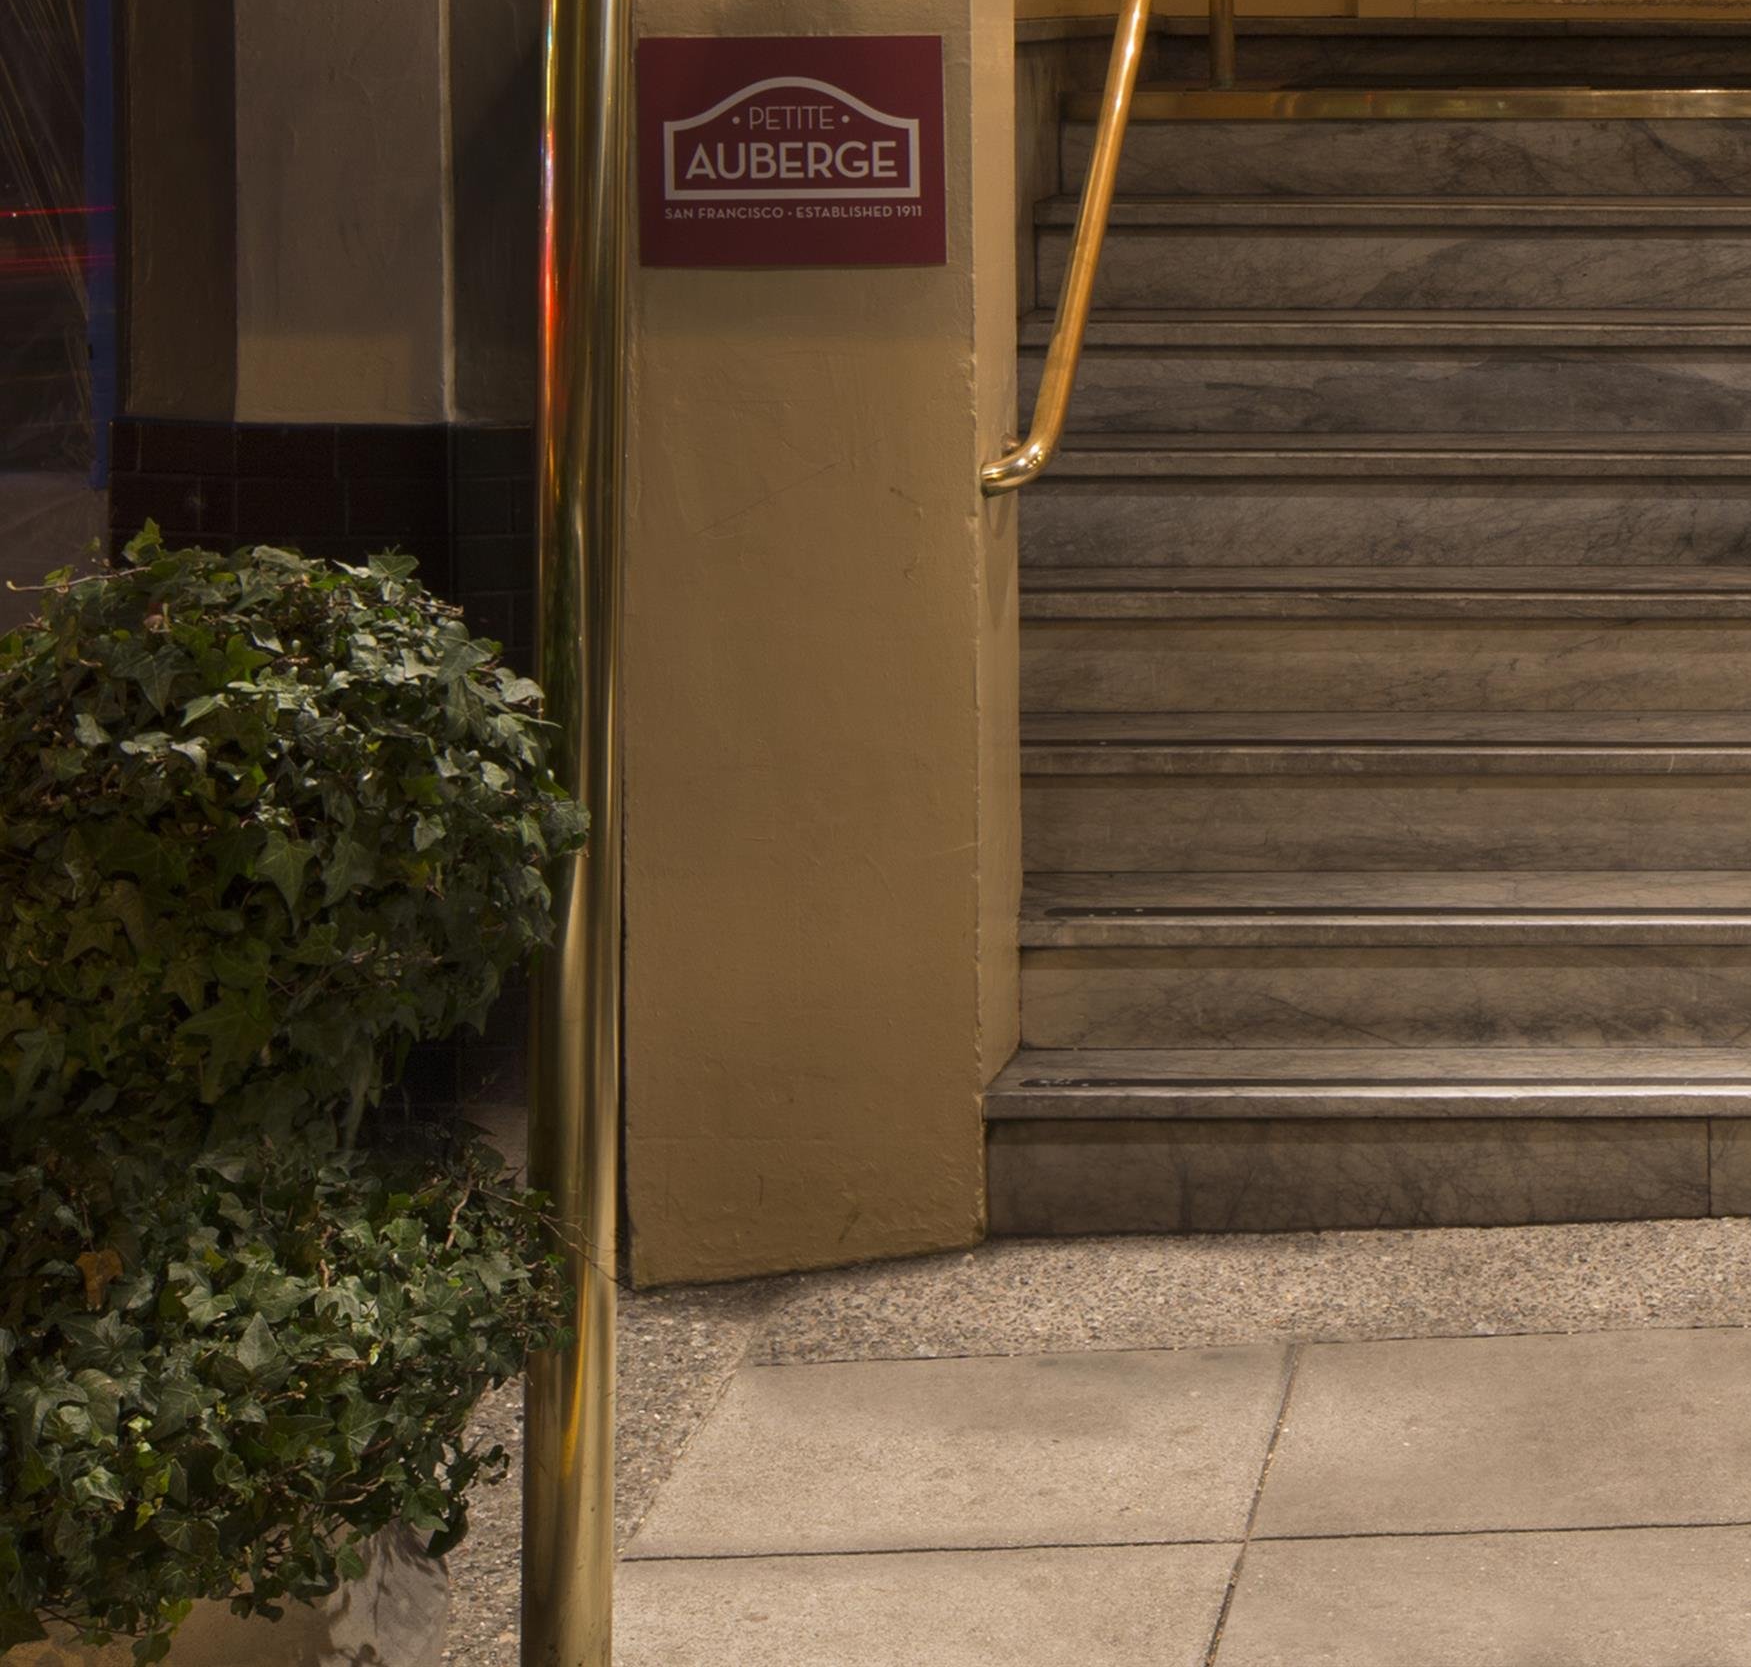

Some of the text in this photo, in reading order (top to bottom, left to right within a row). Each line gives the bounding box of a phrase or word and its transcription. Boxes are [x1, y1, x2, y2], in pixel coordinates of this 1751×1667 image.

[749, 105, 835, 130] PETITE
[685, 140, 898, 180] AUBERGE
[665, 205, 922, 219] SAN FRANCISCO ESTABLISHED 1911
